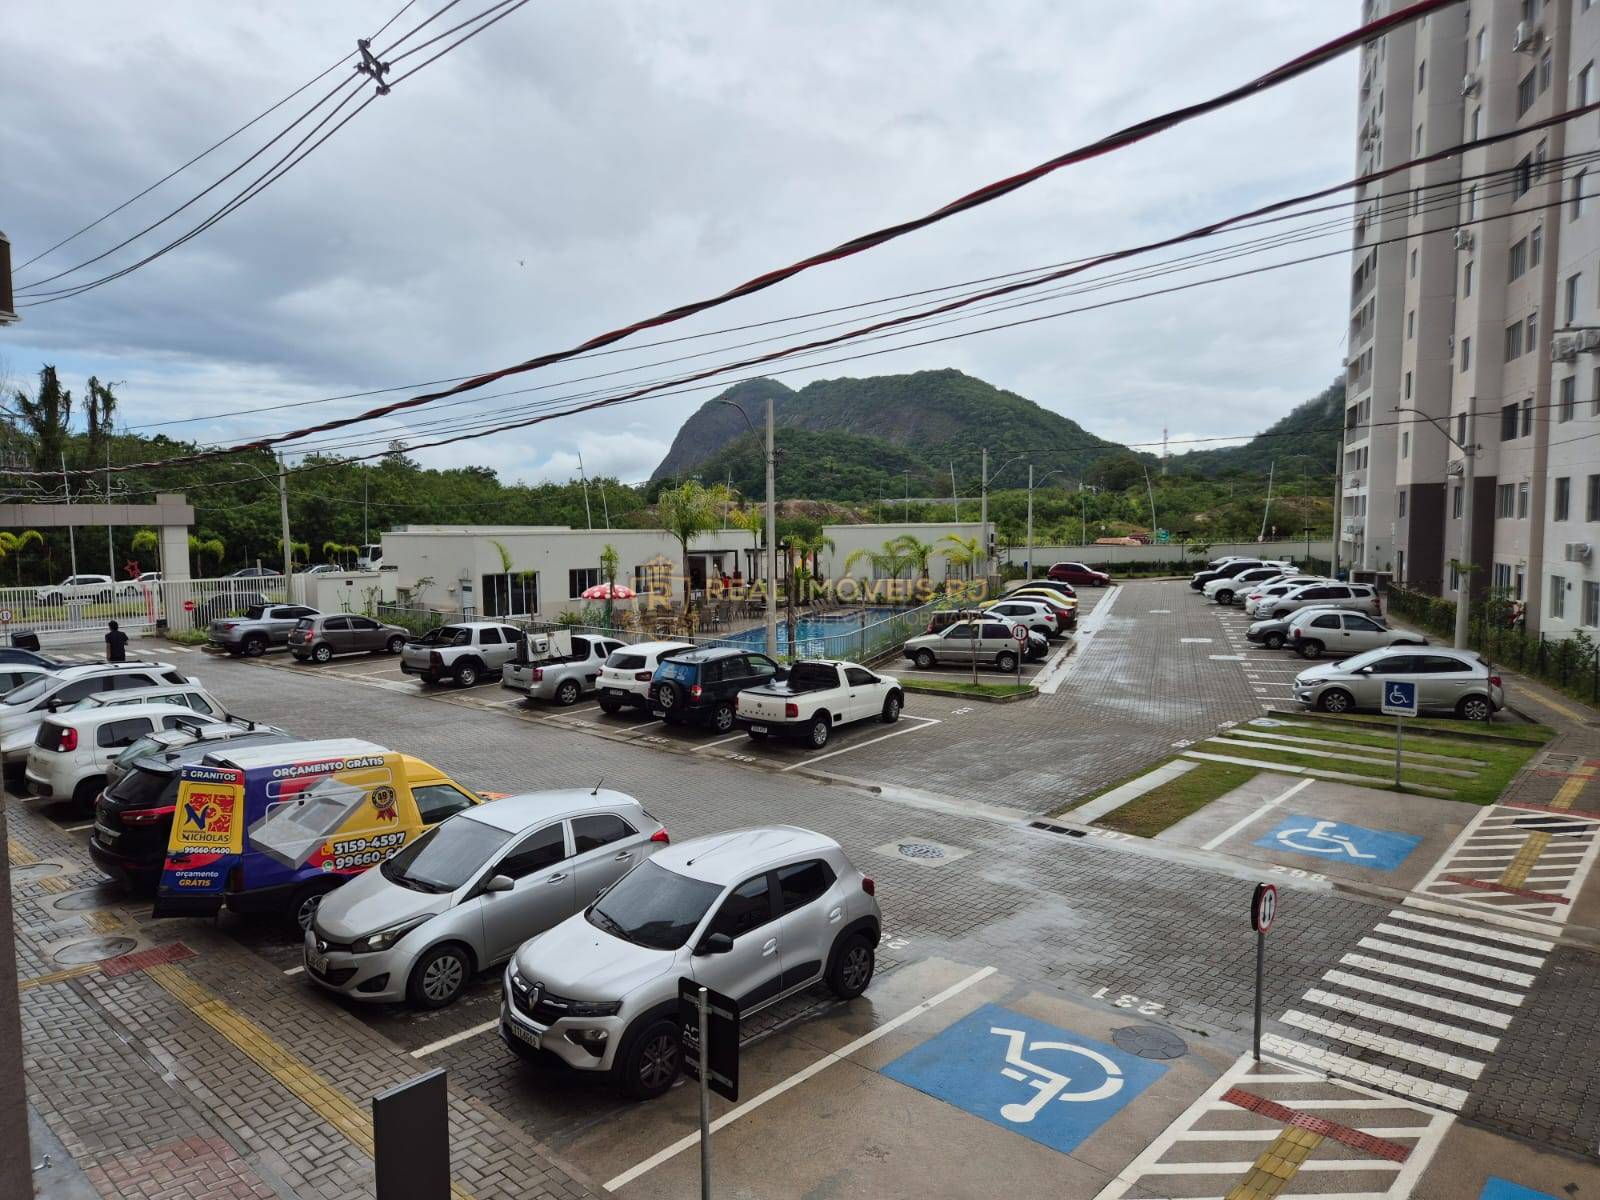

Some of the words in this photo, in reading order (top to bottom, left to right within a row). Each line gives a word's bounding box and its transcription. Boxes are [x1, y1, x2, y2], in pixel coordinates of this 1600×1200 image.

[272, 760, 344, 778] ORÇAMENTO
[346, 756, 385, 769] GRÁTIS
[190, 770, 236, 781] GRANITOS
[182, 832, 230, 842] NICHOLAS
[334, 832, 405, 855] 3159-4597
[175, 869, 219, 879] orçamento
[1091, 986, 1167, 1015] 231
